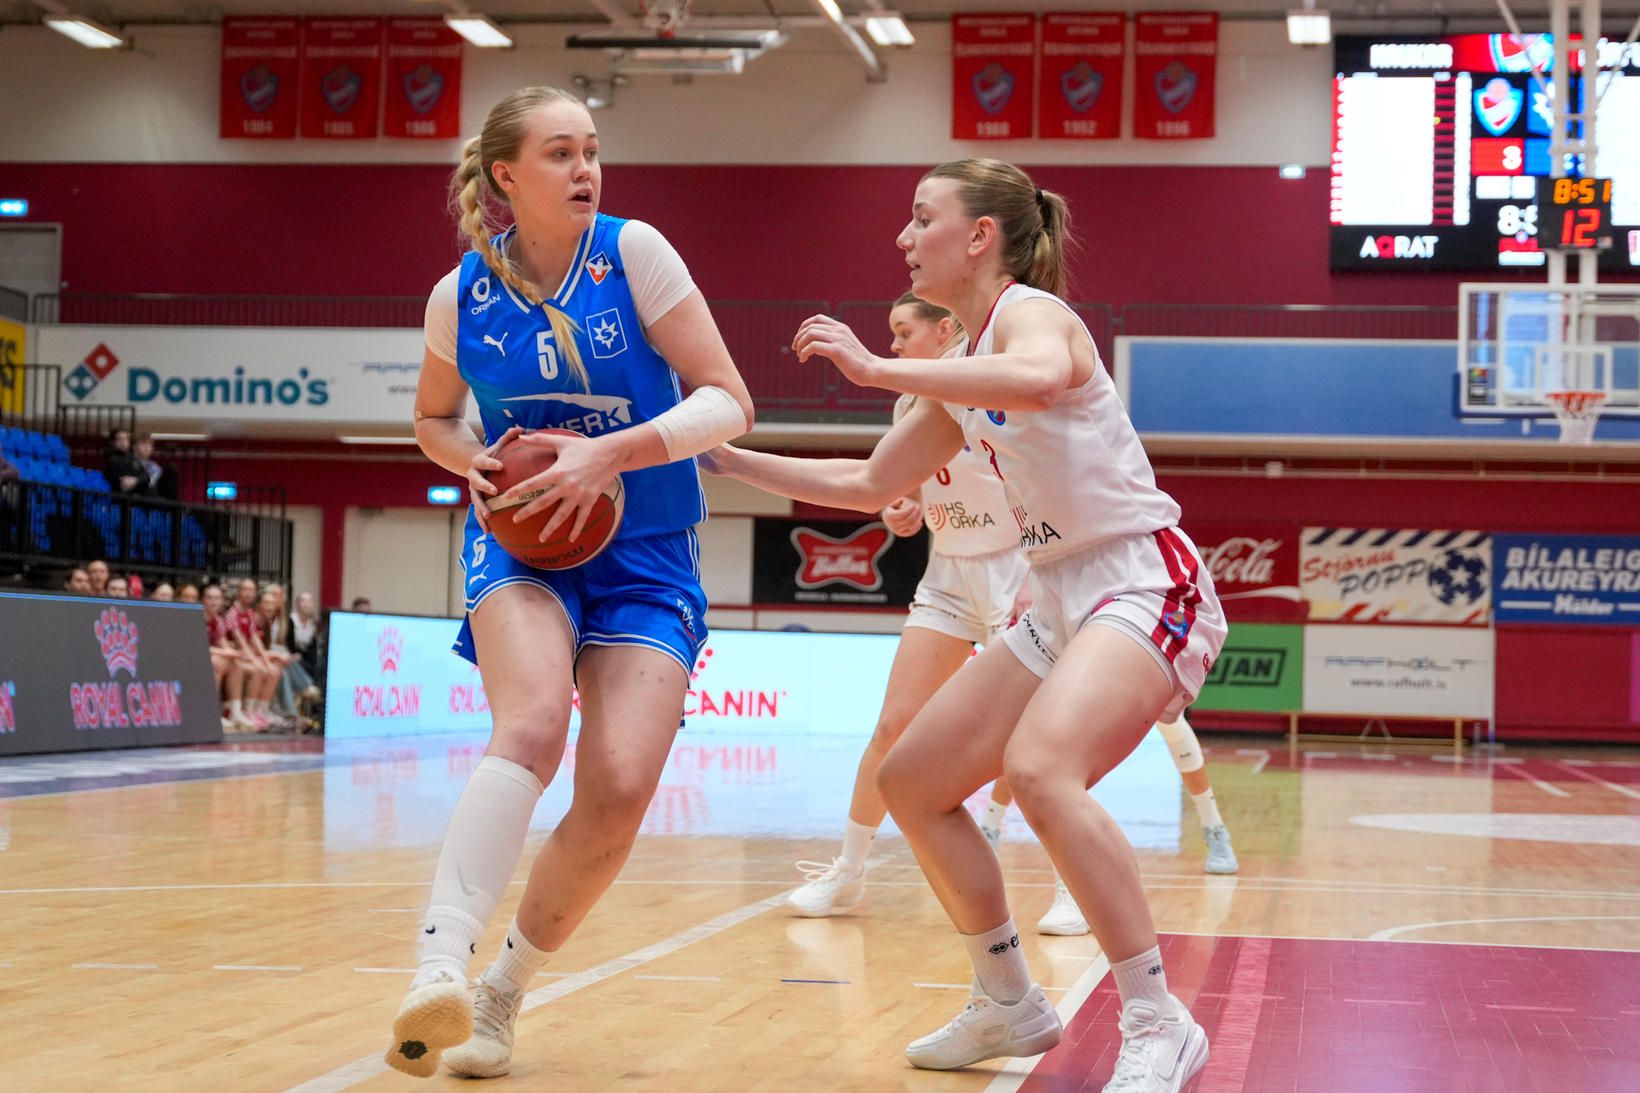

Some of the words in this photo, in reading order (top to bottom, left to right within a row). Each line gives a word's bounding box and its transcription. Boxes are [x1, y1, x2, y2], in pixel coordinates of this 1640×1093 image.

[1553, 178, 1612, 204] 8:51
[1562, 208, 1600, 247] 12
[537, 330, 559, 380] 5
[127, 366, 330, 406] Domino's
[945, 502, 965, 515] HS
[949, 513, 995, 529] ORKA
[1339, 558, 1427, 600] POPP
[71, 682, 129, 729] ROYAL
[126, 681, 181, 727] CANIN
[683, 690, 777, 717] CANIN
